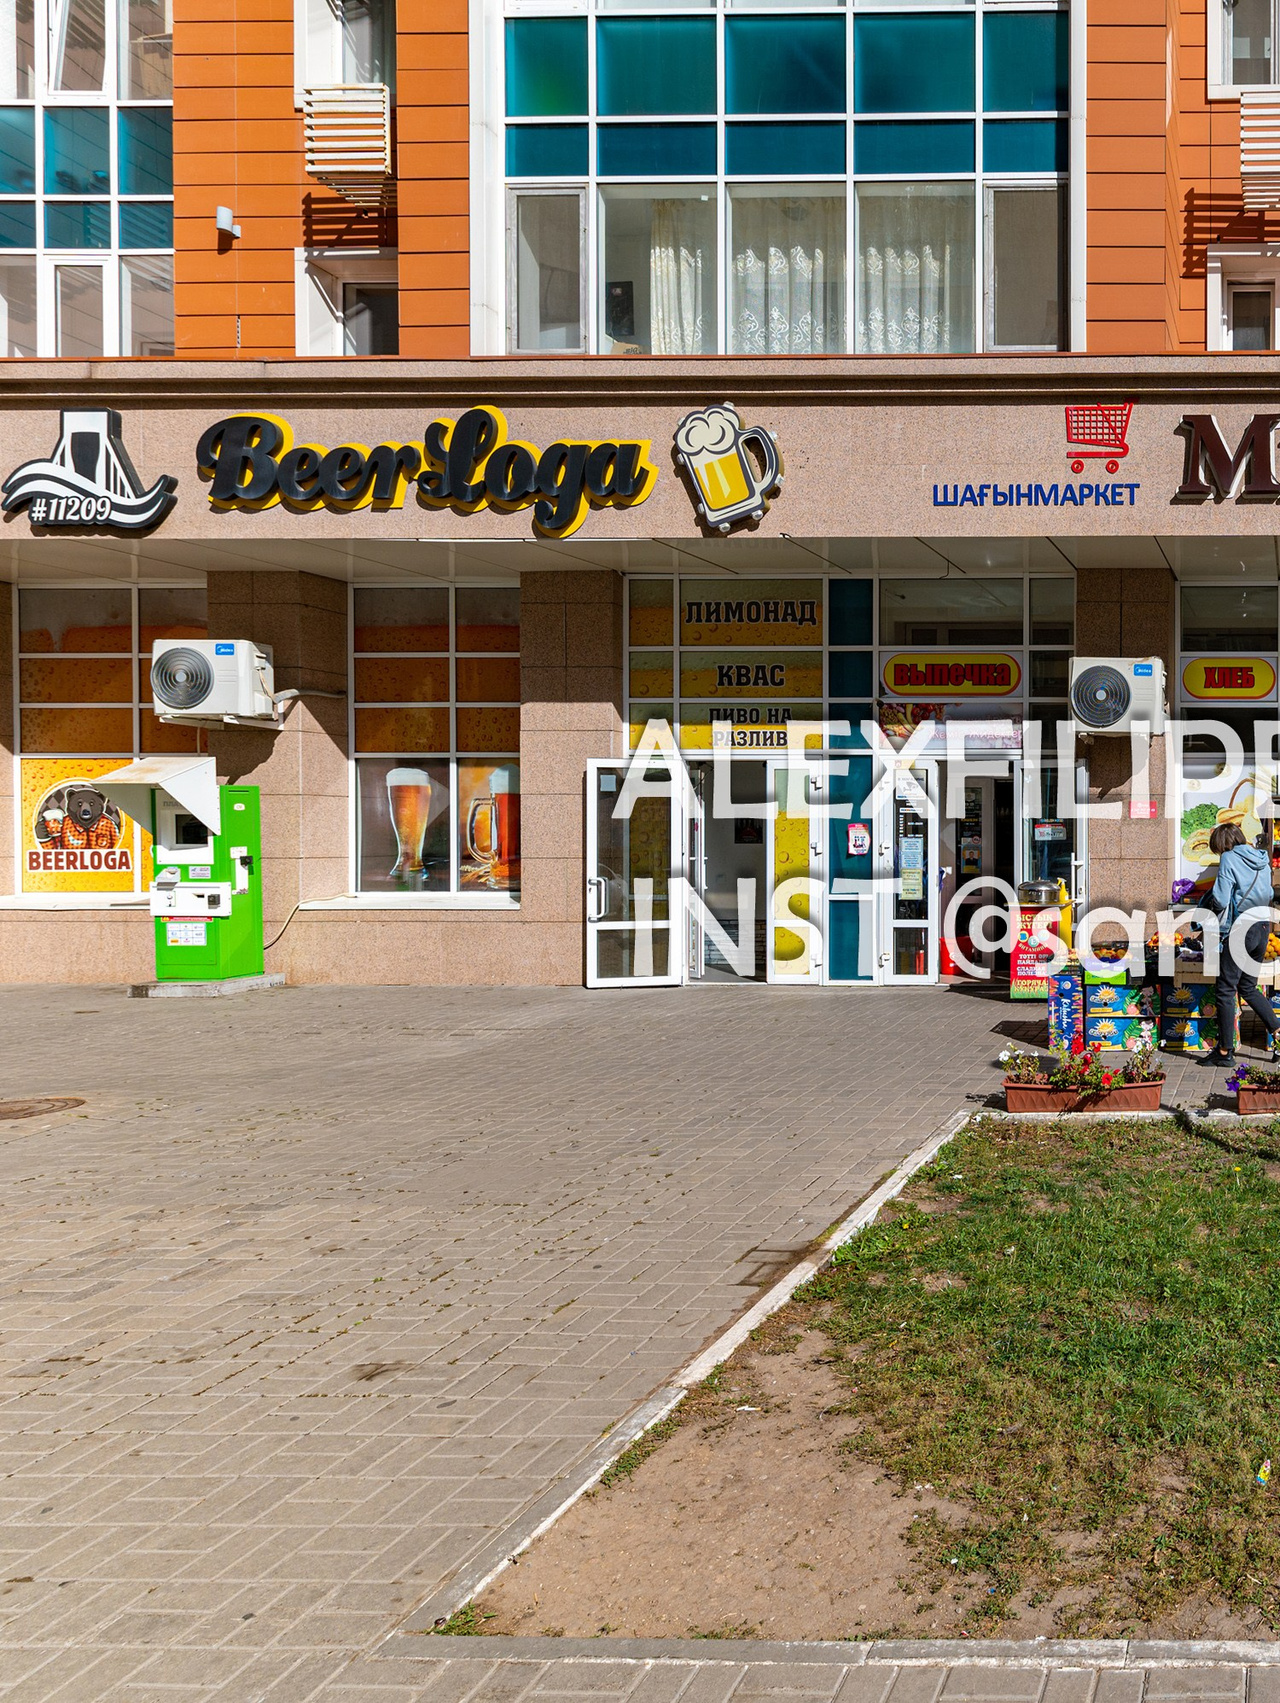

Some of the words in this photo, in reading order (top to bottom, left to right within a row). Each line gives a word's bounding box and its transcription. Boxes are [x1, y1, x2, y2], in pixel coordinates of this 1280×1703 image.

[932, 481, 1141, 507] ШАҒЫНМАРКЕТ
[30, 496, 112, 523] #11209
[685, 600, 818, 626] ЛИМОНАД
[716, 664, 786, 687] КВАС
[1203, 666, 1256, 689] ХЛЕБ
[708, 708, 760, 724] ПИВО
[766, 708, 793, 724] НА
[713, 730, 788, 747] РАЗЛИВ
[28, 850, 132, 871] BEERLOGA
